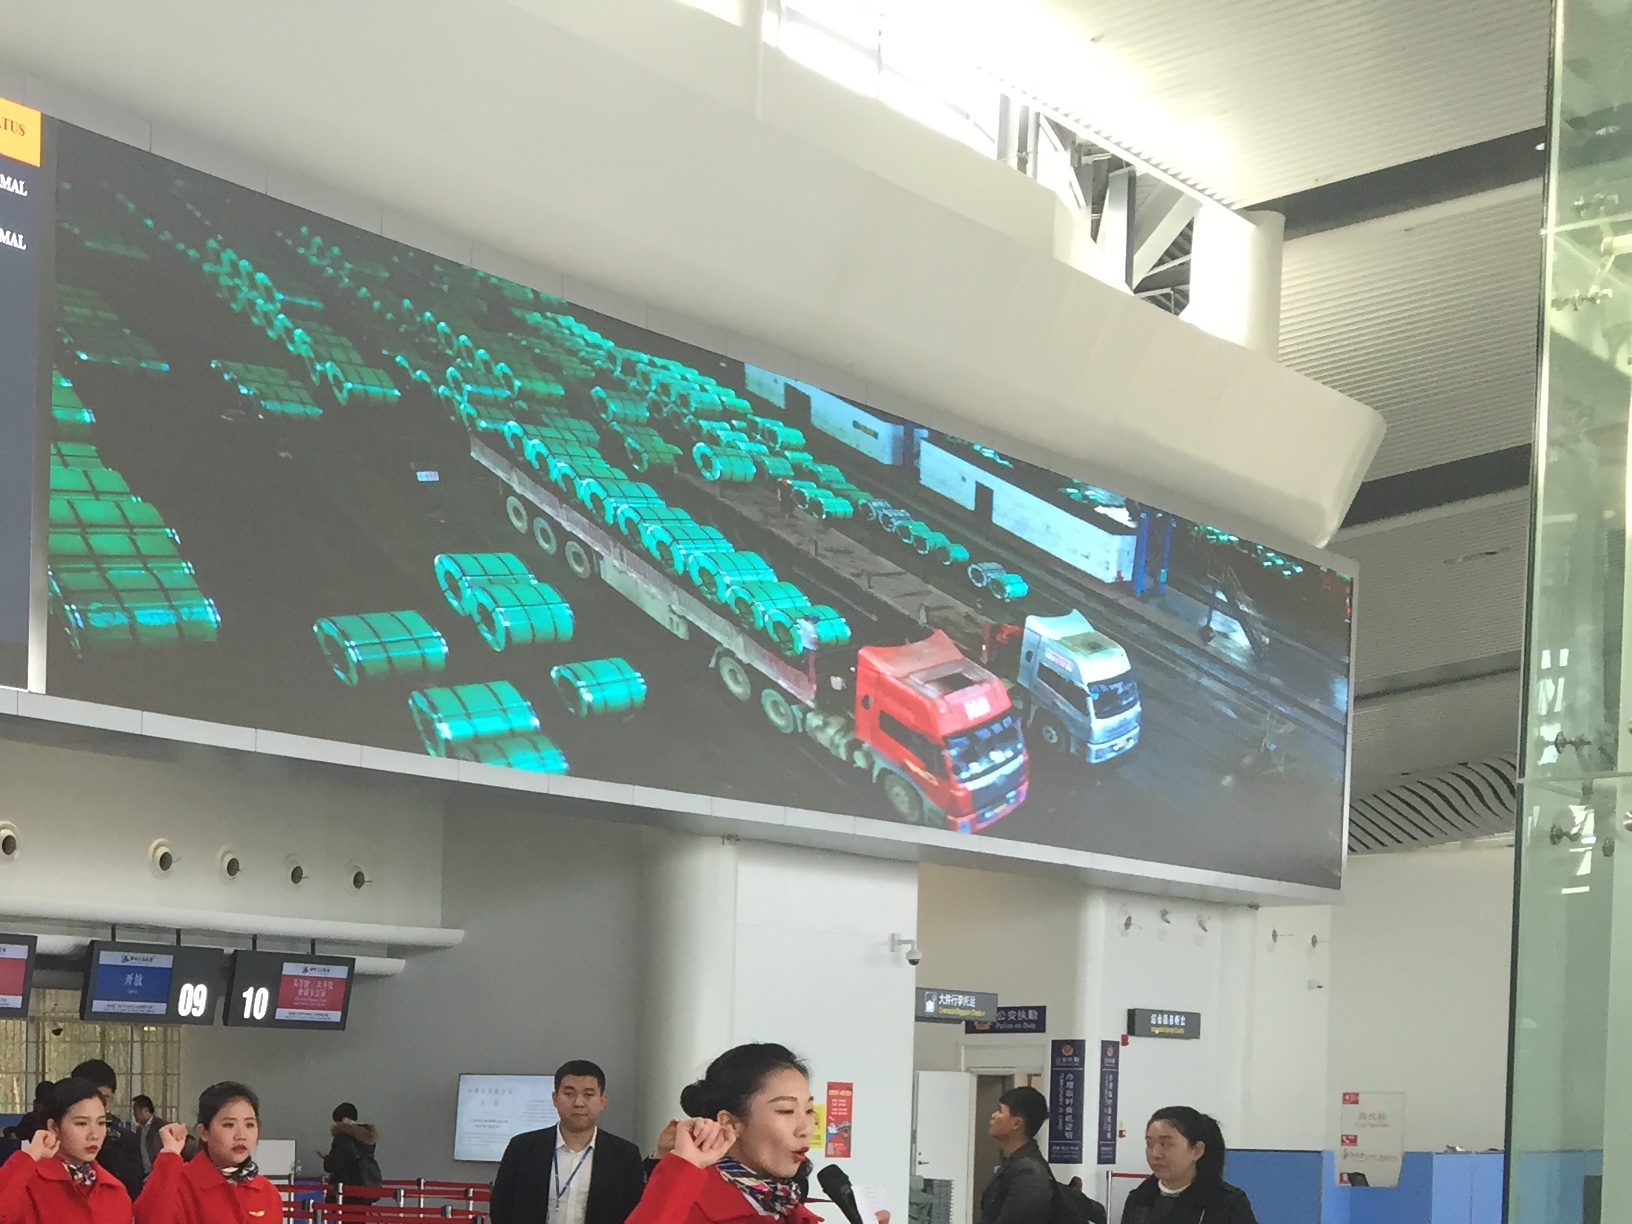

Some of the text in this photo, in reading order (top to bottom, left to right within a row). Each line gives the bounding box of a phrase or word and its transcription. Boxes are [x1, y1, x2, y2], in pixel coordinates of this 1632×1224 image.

[178, 983, 208, 1017] 09
[242, 986, 269, 1020] 10
[997, 1009, 1038, 1021] 公安执勤
